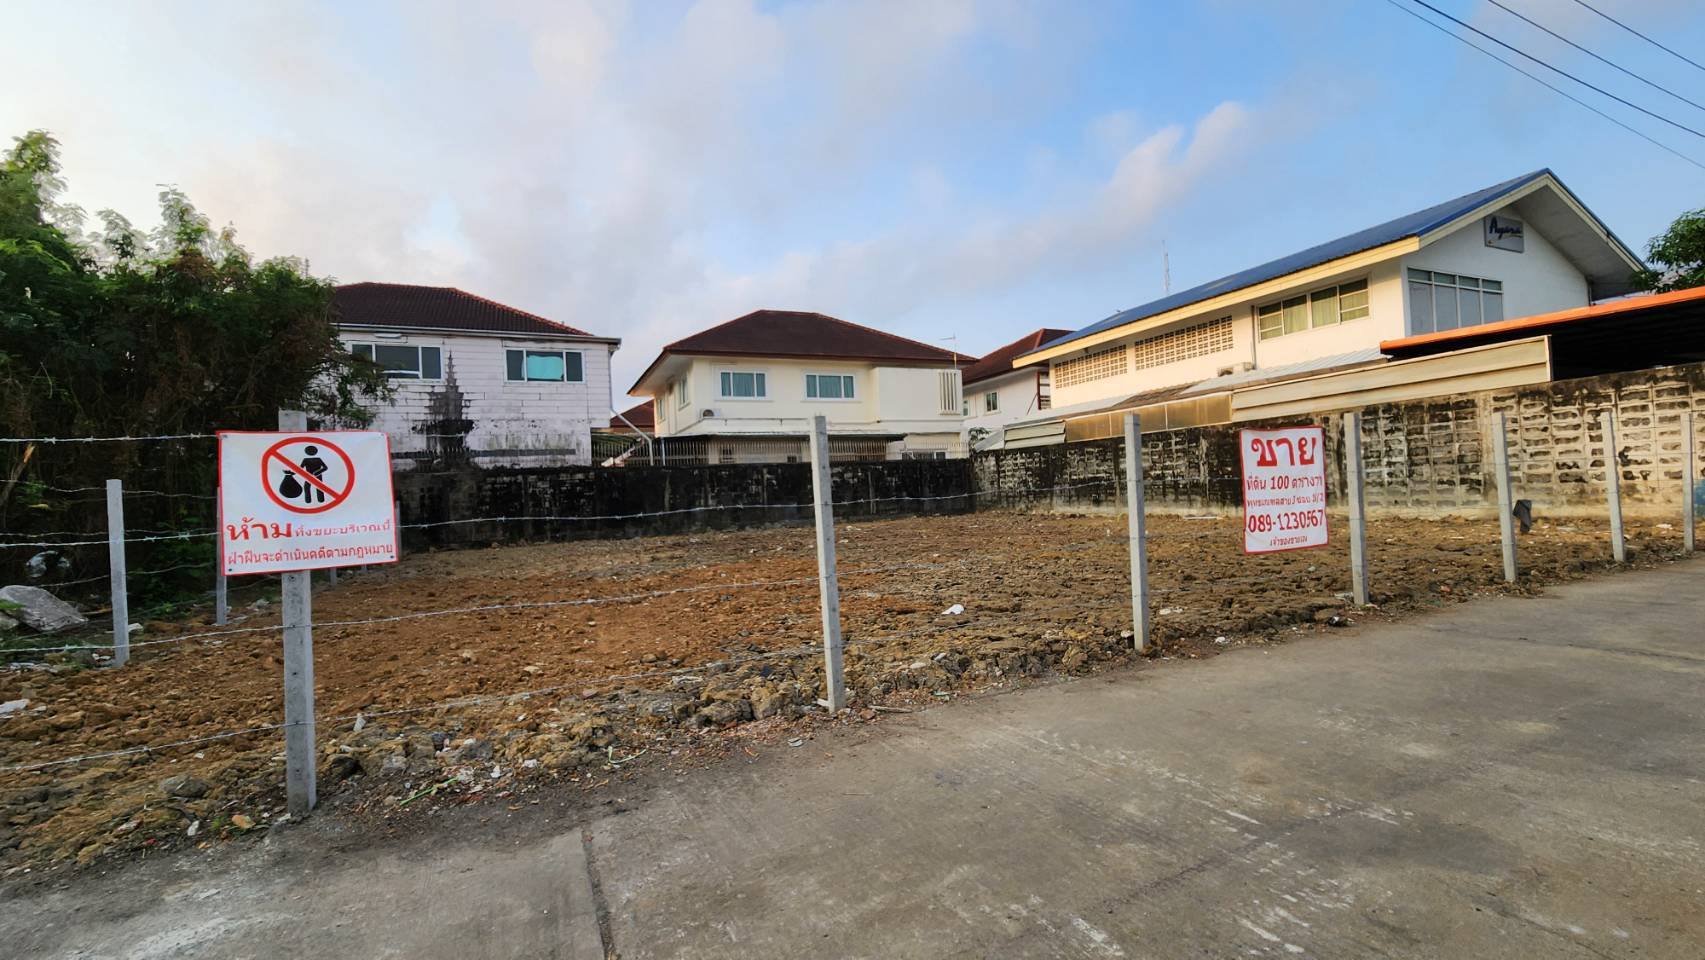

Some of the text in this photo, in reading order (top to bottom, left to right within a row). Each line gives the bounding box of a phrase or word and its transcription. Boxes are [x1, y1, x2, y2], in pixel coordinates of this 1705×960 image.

[1251, 437, 1316, 467] ขาย
[1247, 472, 1266, 490] ที่ดิน
[1270, 476, 1290, 489] 100
[226, 517, 292, 540] ห้าม
[1248, 509, 1323, 532] 089-1230567
